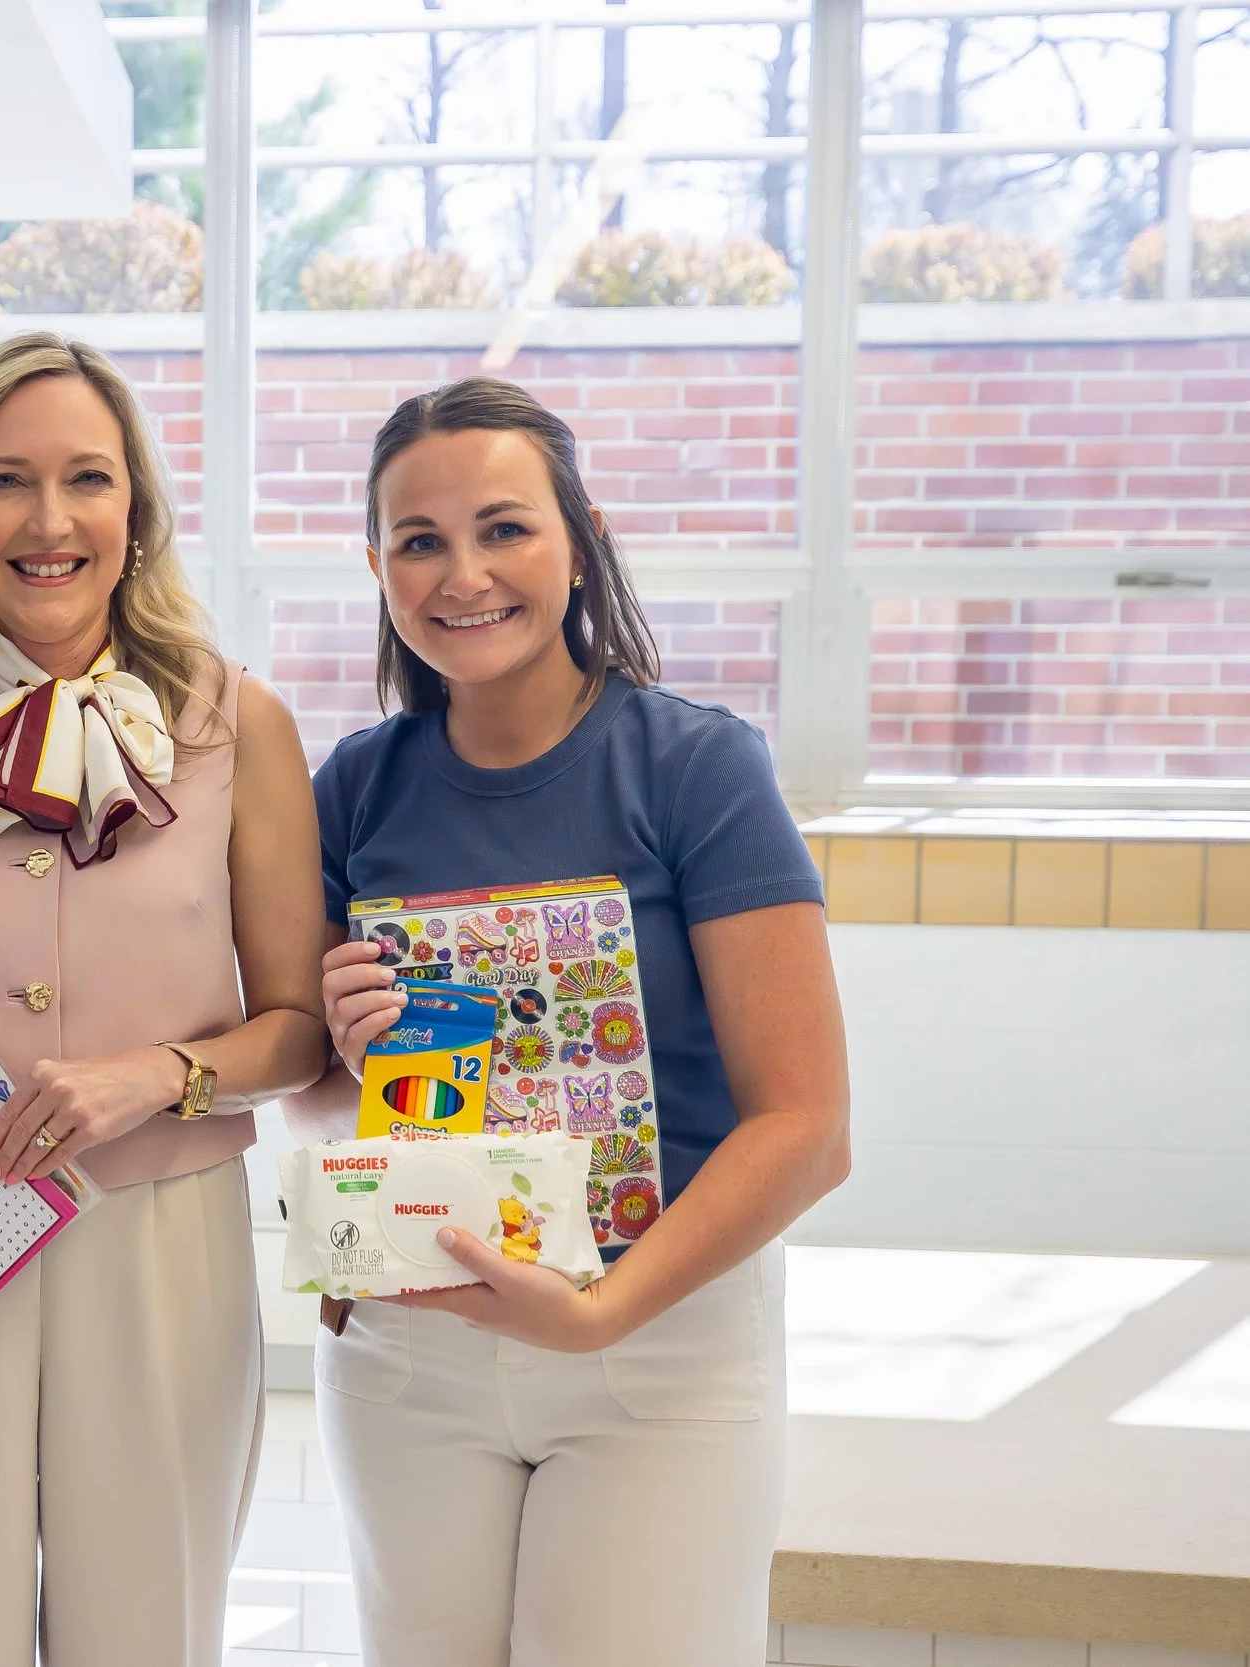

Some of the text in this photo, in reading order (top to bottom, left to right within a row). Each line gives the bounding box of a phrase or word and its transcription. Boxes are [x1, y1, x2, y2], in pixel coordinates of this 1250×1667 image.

[393, 966, 450, 979] OOVY
[466, 967, 538, 986] Good Day
[451, 1054, 482, 1082] 12
[487, 1149, 492, 1159] 1
[322, 1158, 388, 1172] HUGGIES
[330, 1172, 383, 1181] natural care
[395, 1204, 449, 1215] HUGGIES
[332, 1249, 384, 1266] DO NOT FLUSH
[332, 1264, 385, 1276] PAS AUX TOILETTES
